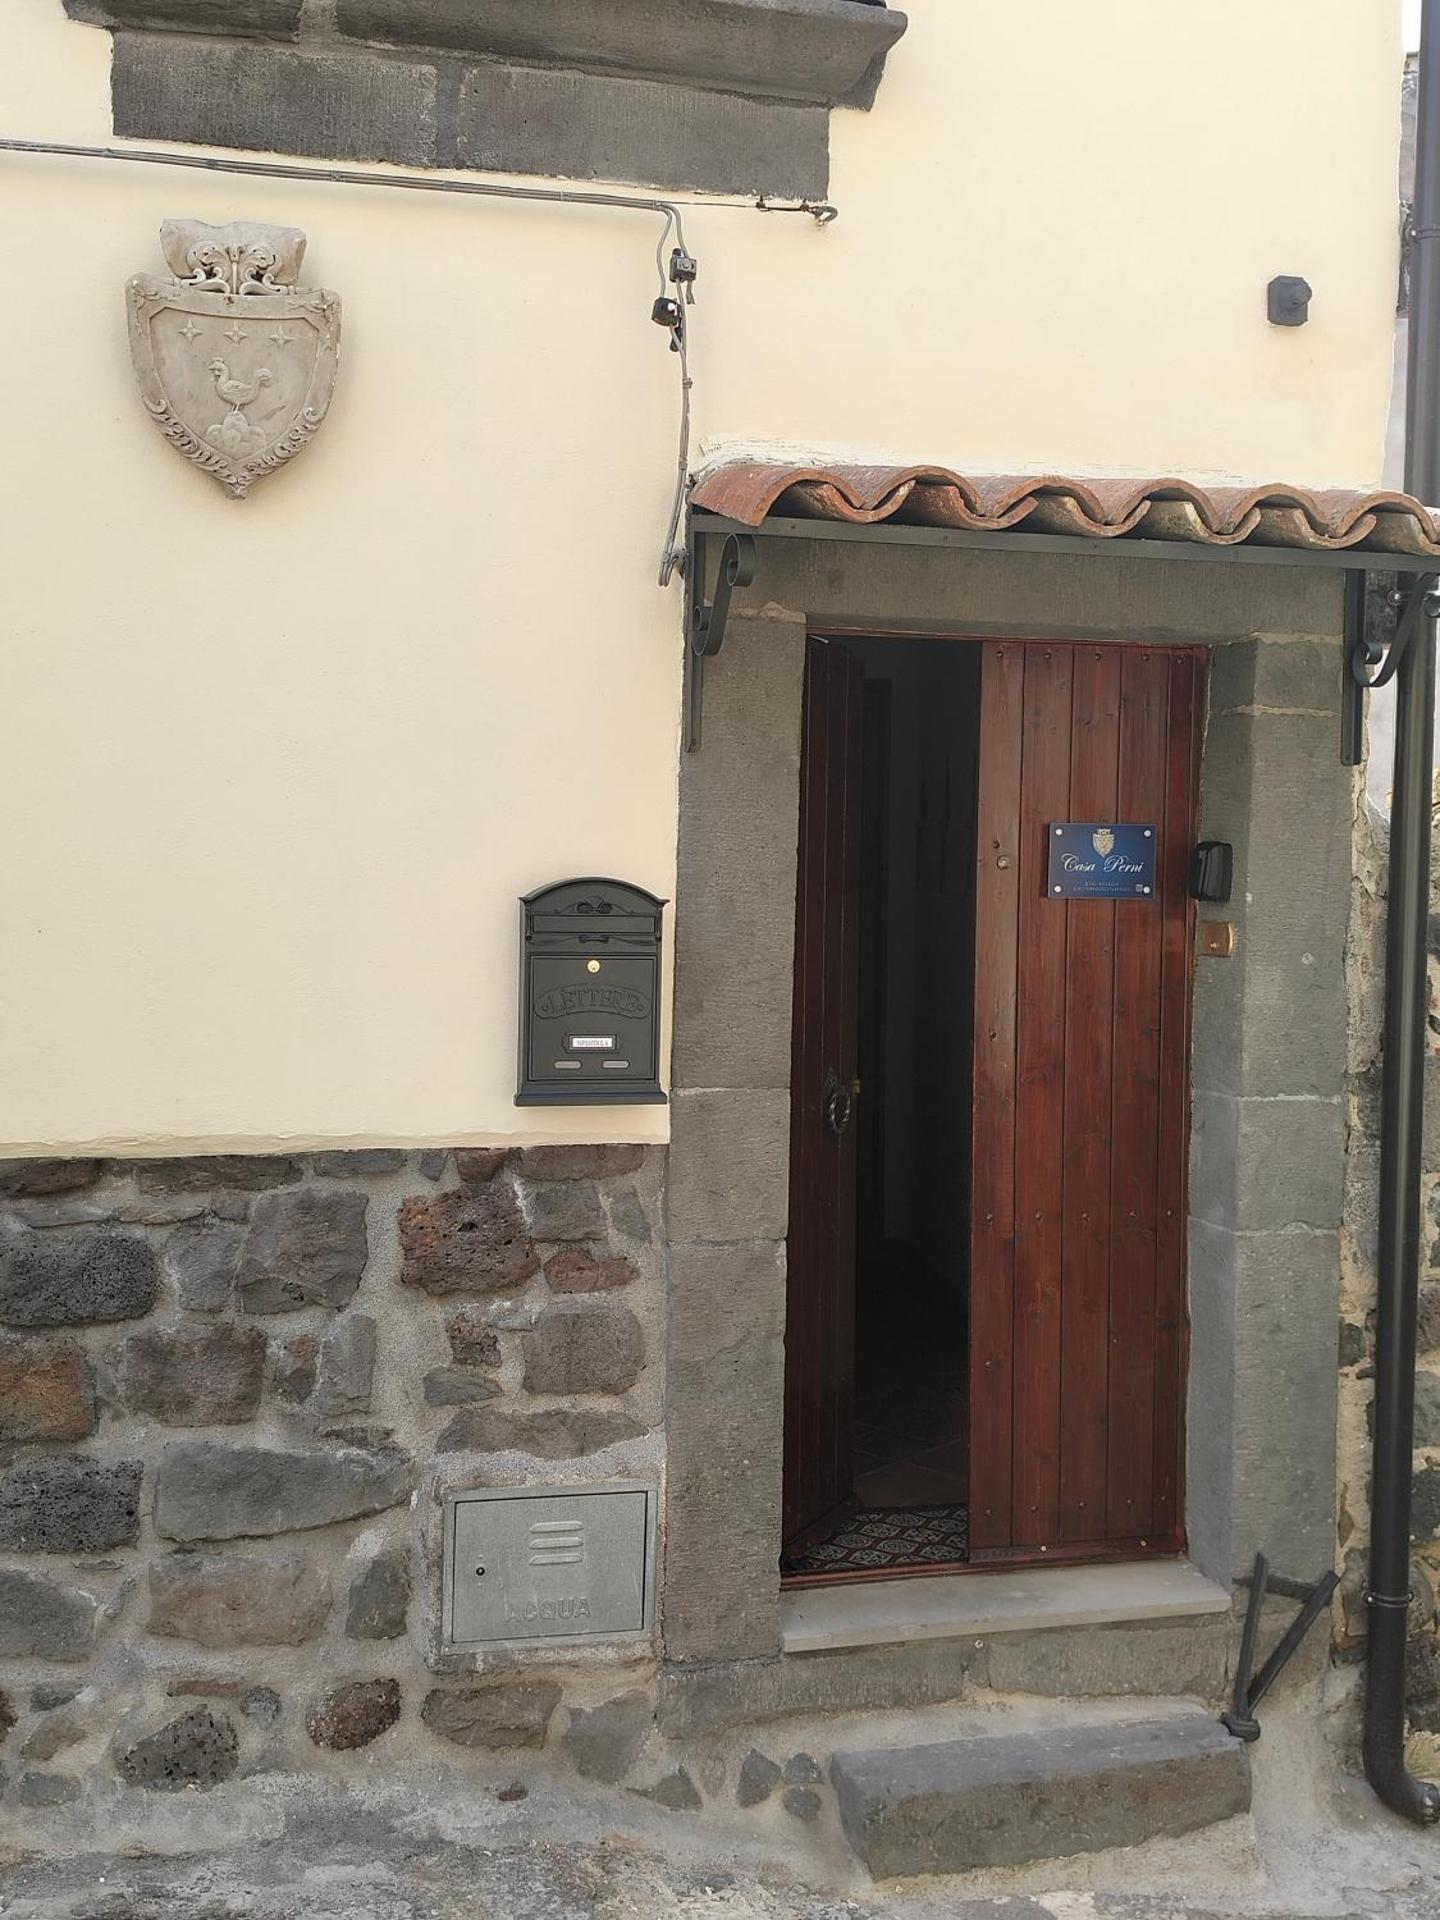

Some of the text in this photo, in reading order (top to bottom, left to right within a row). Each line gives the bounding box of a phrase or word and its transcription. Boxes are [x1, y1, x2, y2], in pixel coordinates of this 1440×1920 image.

[1061, 853, 1144, 873] Casa Perni
[506, 1597, 590, 1622] ACQUA
